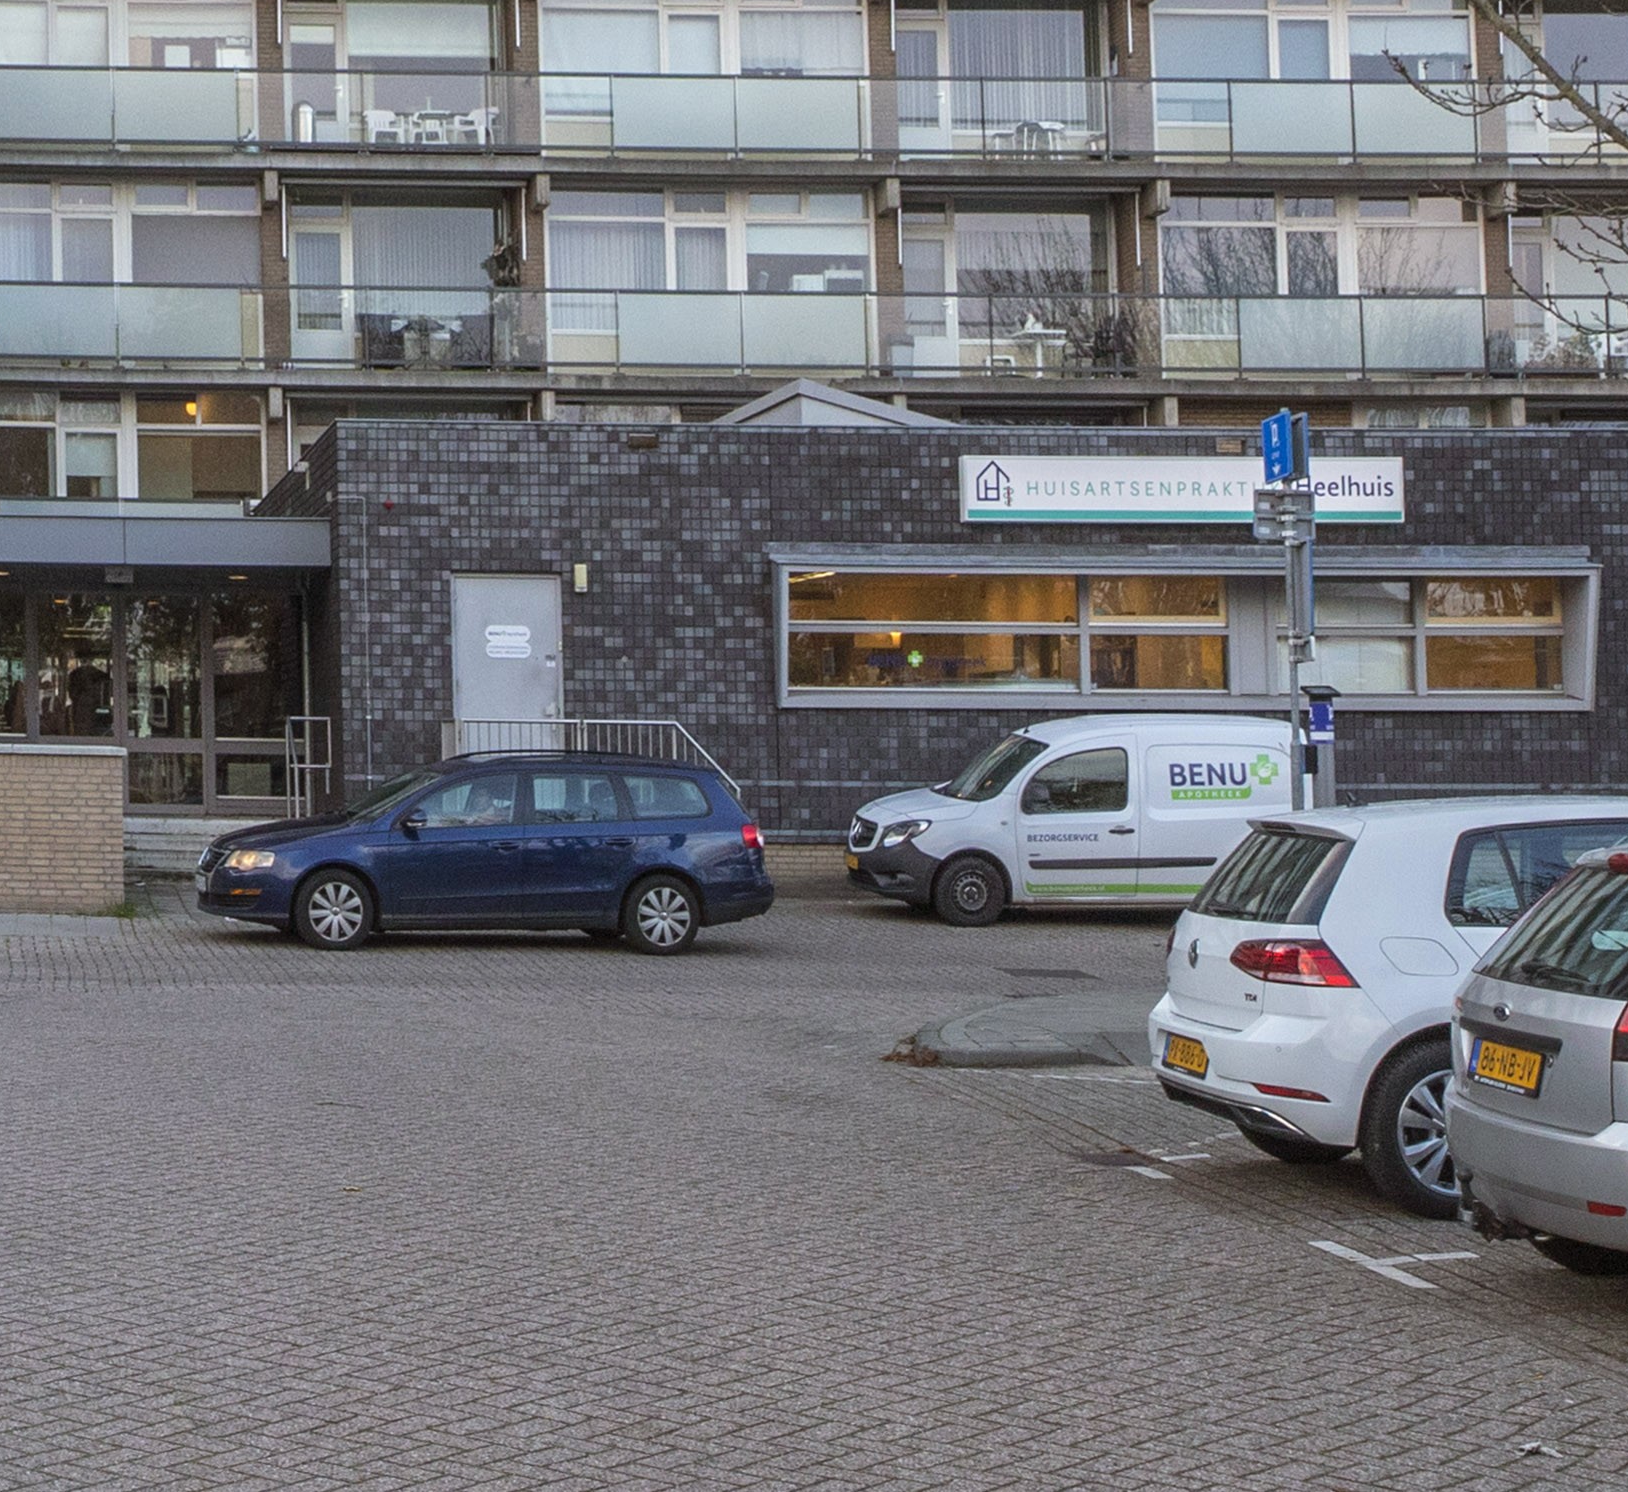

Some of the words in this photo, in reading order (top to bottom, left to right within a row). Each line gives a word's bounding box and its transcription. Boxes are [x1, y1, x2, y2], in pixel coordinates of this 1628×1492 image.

[1296, 475, 1395, 497] Heelhuis
[1168, 762, 1248, 787] BENU
[1177, 790, 1243, 799] APOTHEEK
[1027, 833, 1099, 843] BEZORGSERVICE
[1481, 1046, 1536, 1083] 86-NB-JV
